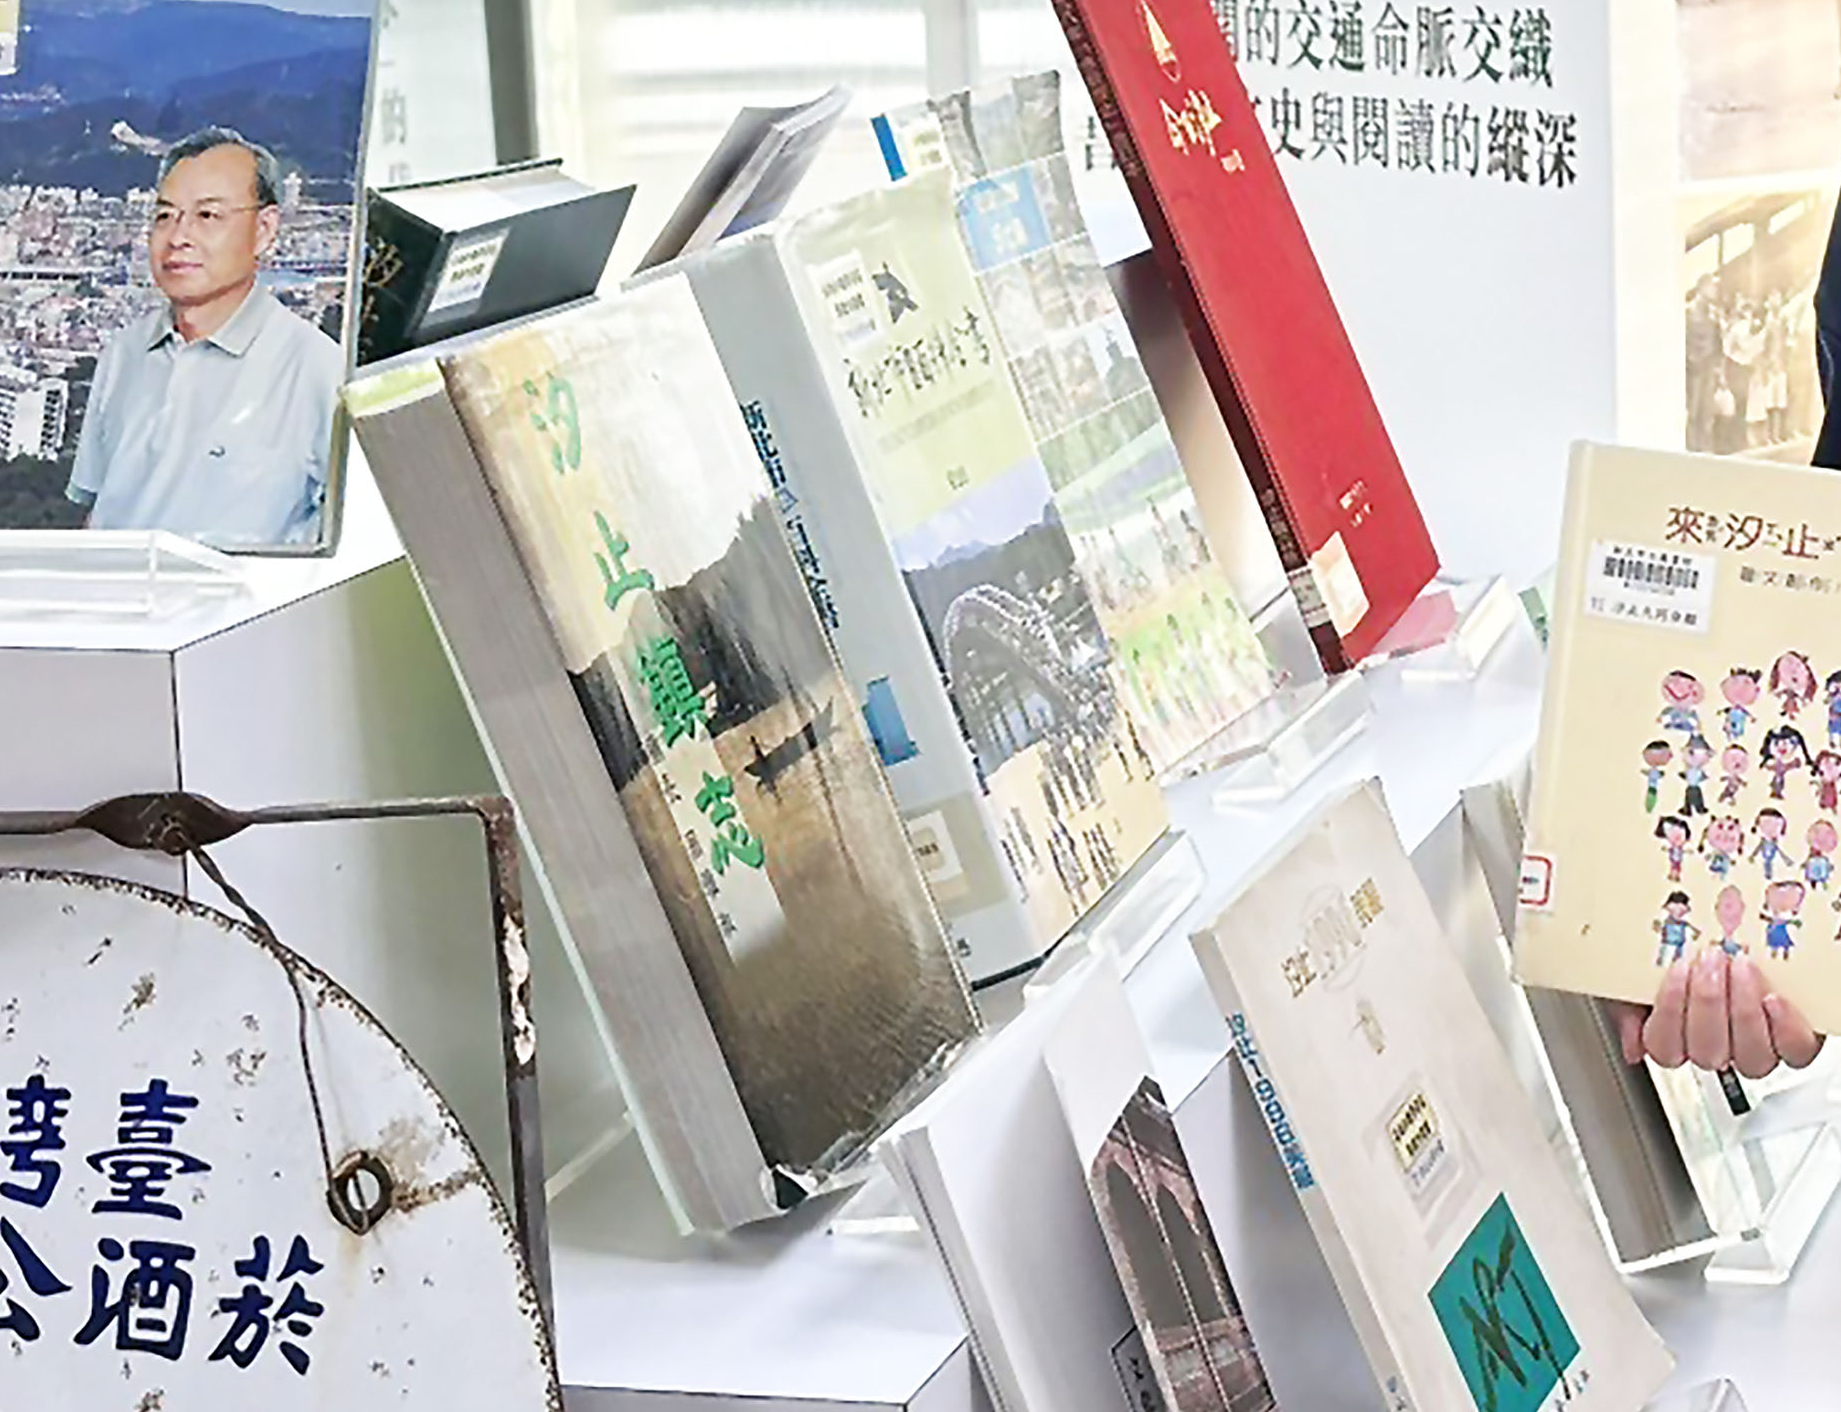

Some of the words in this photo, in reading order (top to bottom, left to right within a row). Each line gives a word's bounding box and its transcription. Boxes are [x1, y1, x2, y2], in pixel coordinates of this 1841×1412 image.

[1250, 86, 1577, 188] 史與閱讀的縱深
